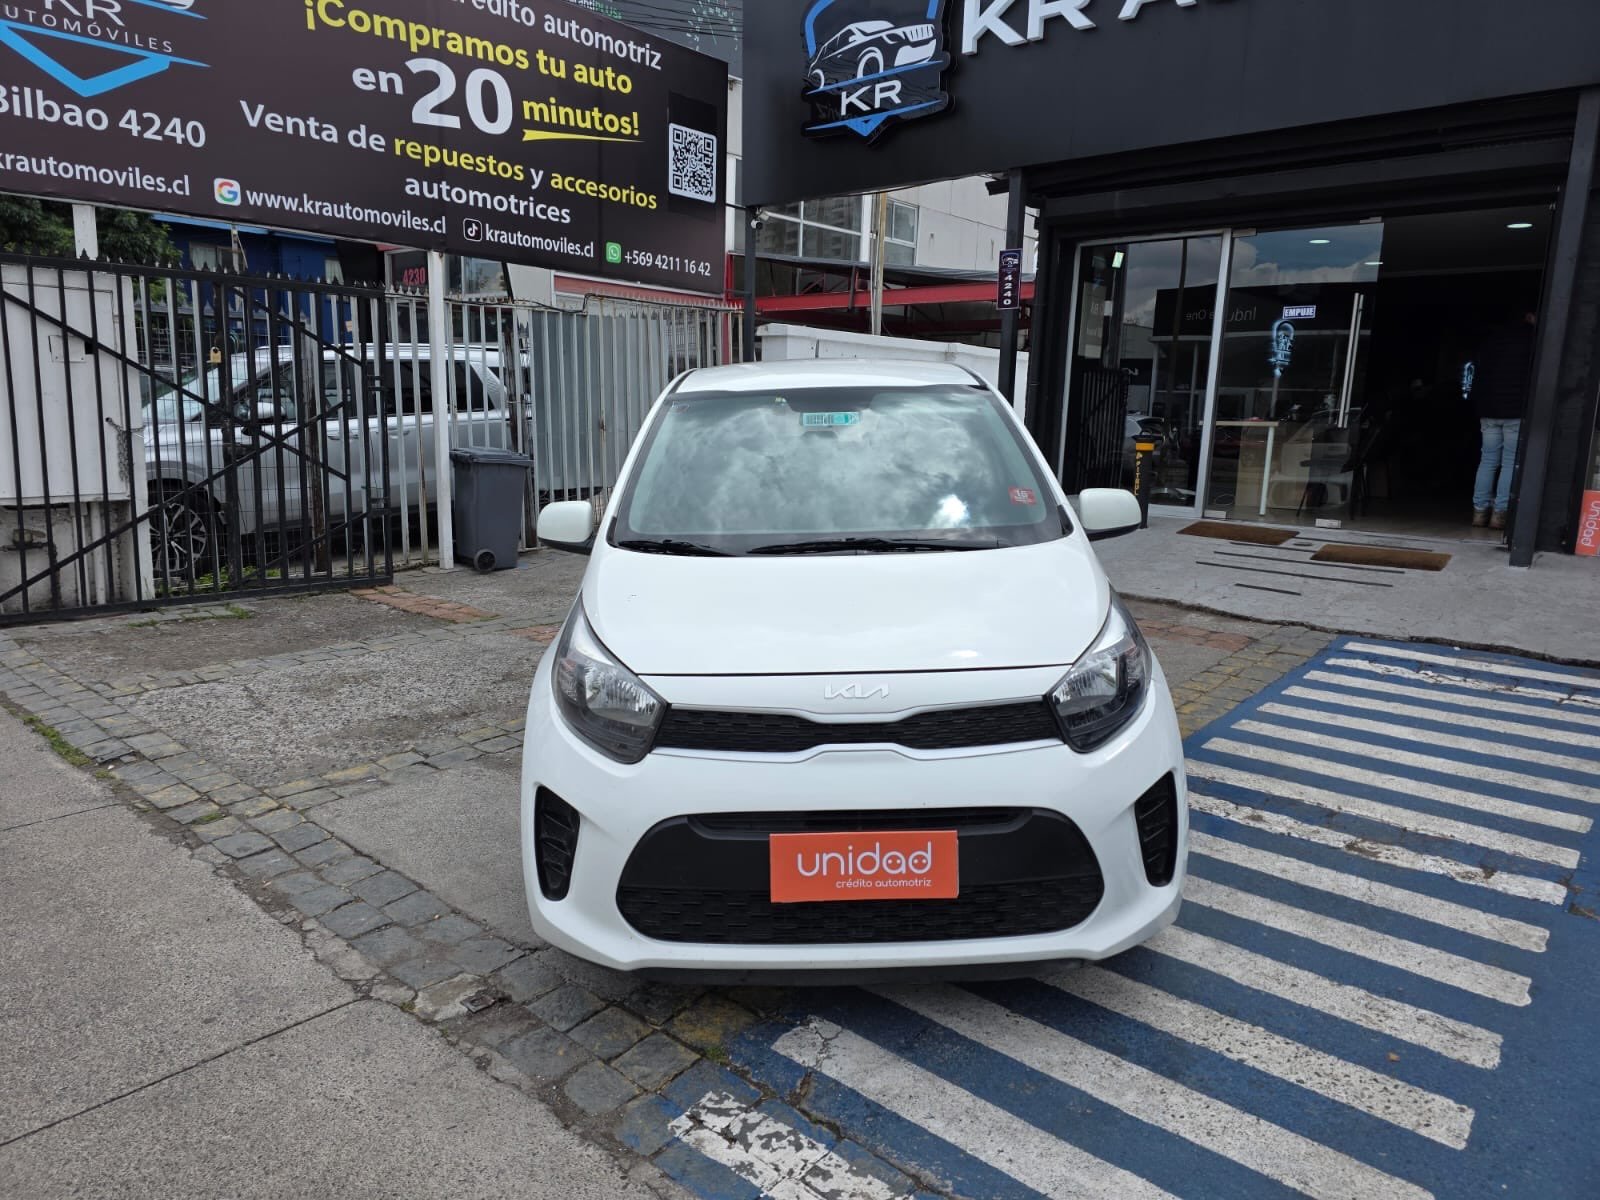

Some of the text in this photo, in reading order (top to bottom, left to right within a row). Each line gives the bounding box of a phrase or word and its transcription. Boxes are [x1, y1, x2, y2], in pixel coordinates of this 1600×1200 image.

[543, 13, 662, 70] automotriz
[536, 49, 566, 78] tu
[573, 62, 632, 94] auto
[352, 57, 640, 136] en 20 minutos!
[840, 79, 902, 116] KR
[118, 108, 207, 148] 4240
[239, 100, 658, 209] Venta de repuestos y accesorios
[246, 189, 446, 234] www.krautomoviles.cl
[404, 177, 571, 224] automotrices
[485, 223, 594, 258] krautomoviles.cl
[403, 266, 426, 286] 4230
[624, 250, 652, 267] +569
[655, 253, 680, 271] 4211
[1285, 306, 1315, 317] EMPUJE
[797, 841, 933, 877] unidad
[835, 877, 933, 889] crédito automotriz
